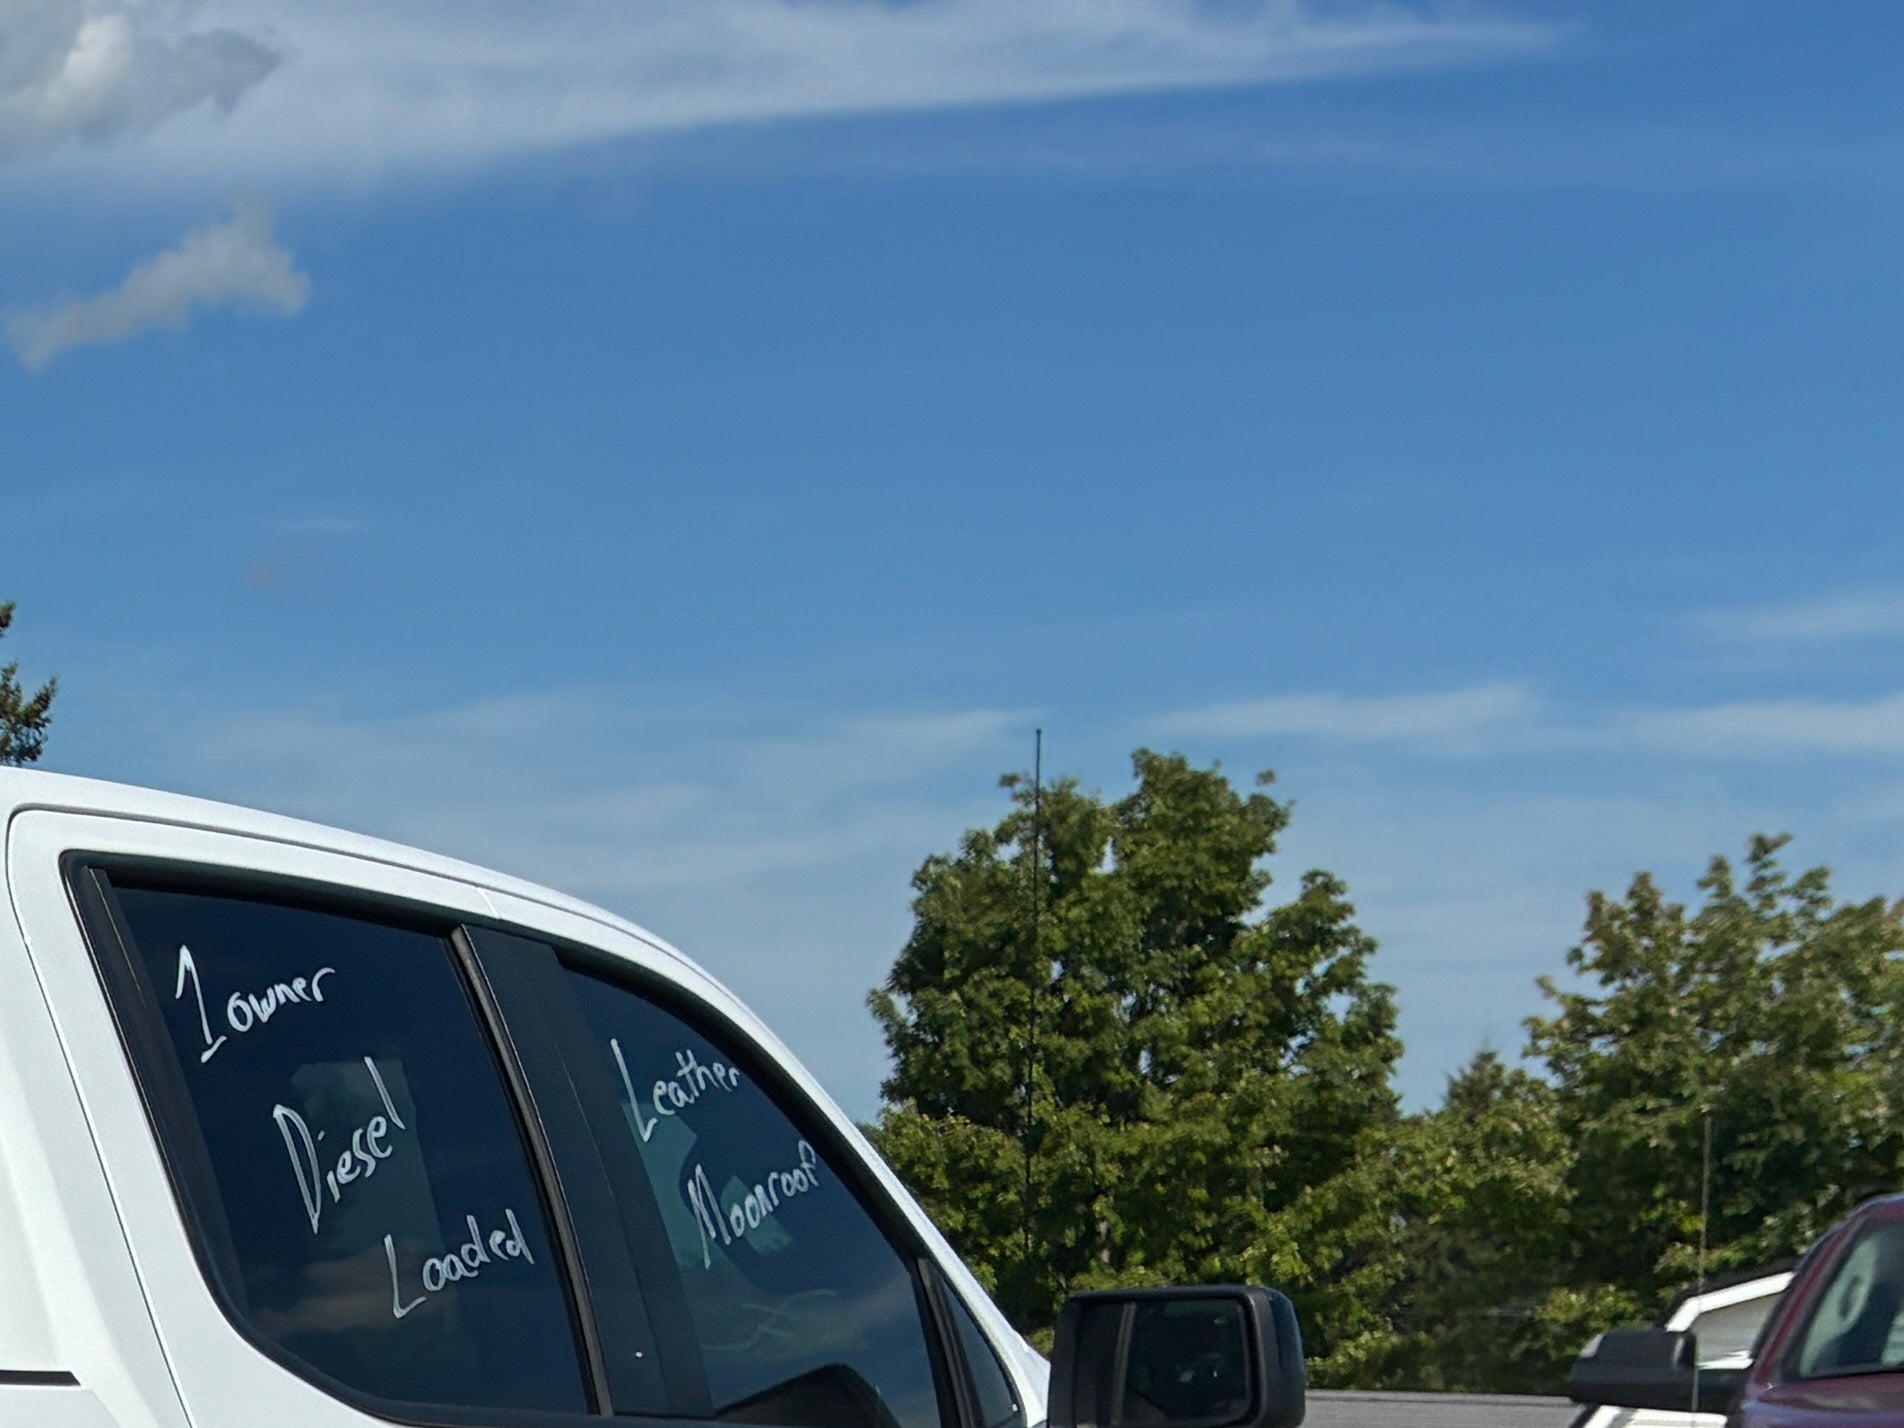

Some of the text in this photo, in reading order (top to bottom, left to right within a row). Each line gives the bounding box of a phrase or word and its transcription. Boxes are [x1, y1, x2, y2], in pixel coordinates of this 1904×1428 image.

[176, 944, 336, 1063] 1 owner
[272, 1056, 406, 1234] Diesel
[610, 1038, 741, 1142] Leather
[384, 1208, 534, 1319] Loaded
[688, 1140, 819, 1270] Moonroof
